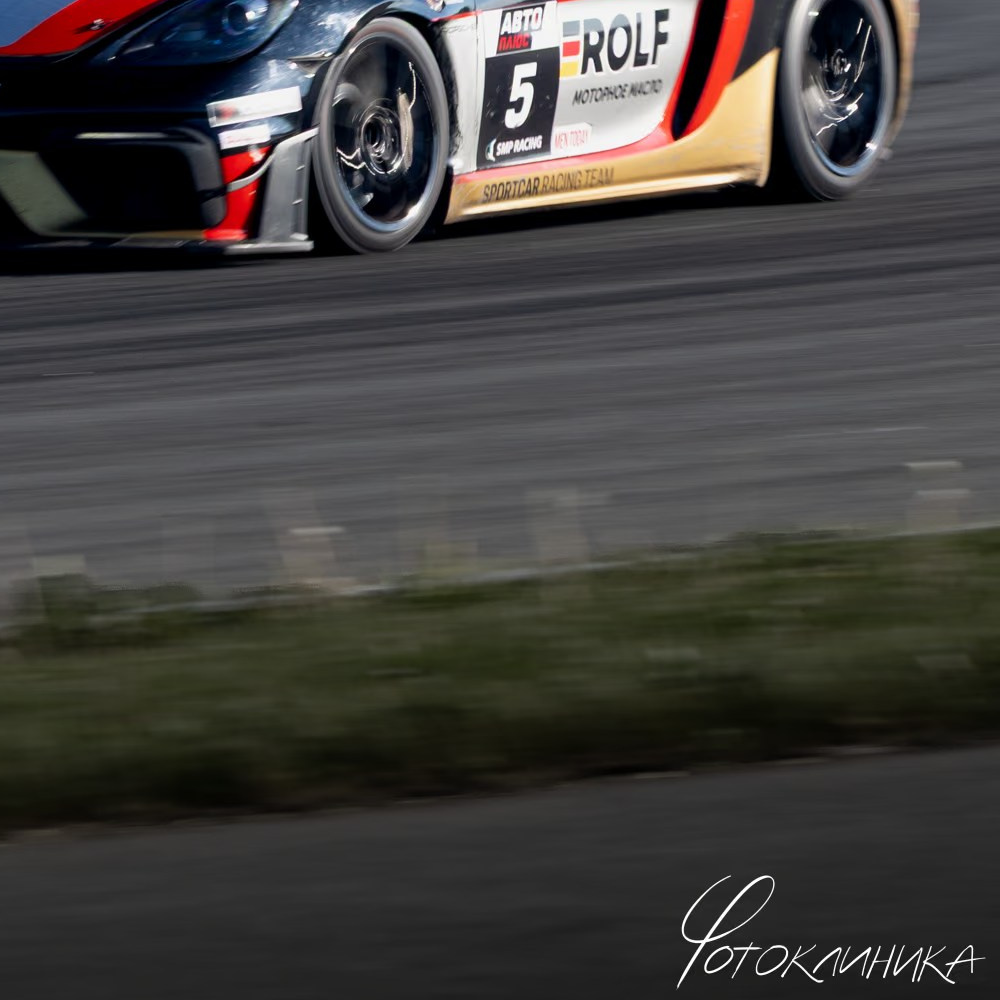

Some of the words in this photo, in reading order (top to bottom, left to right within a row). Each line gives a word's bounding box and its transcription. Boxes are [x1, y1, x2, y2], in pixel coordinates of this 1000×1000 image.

[500, 6, 543, 36] АВТО
[581, 8, 669, 75] ROLF
[504, 61, 538, 129] 5
[572, 83, 629, 107] МОТОРНОЕ
[496, 139, 514, 157] SMP
[513, 134, 543, 153] RACING
[483, 177, 541, 204] SPORTCAR
[541, 169, 582, 194] RACING
[584, 167, 614, 188] TEAM
